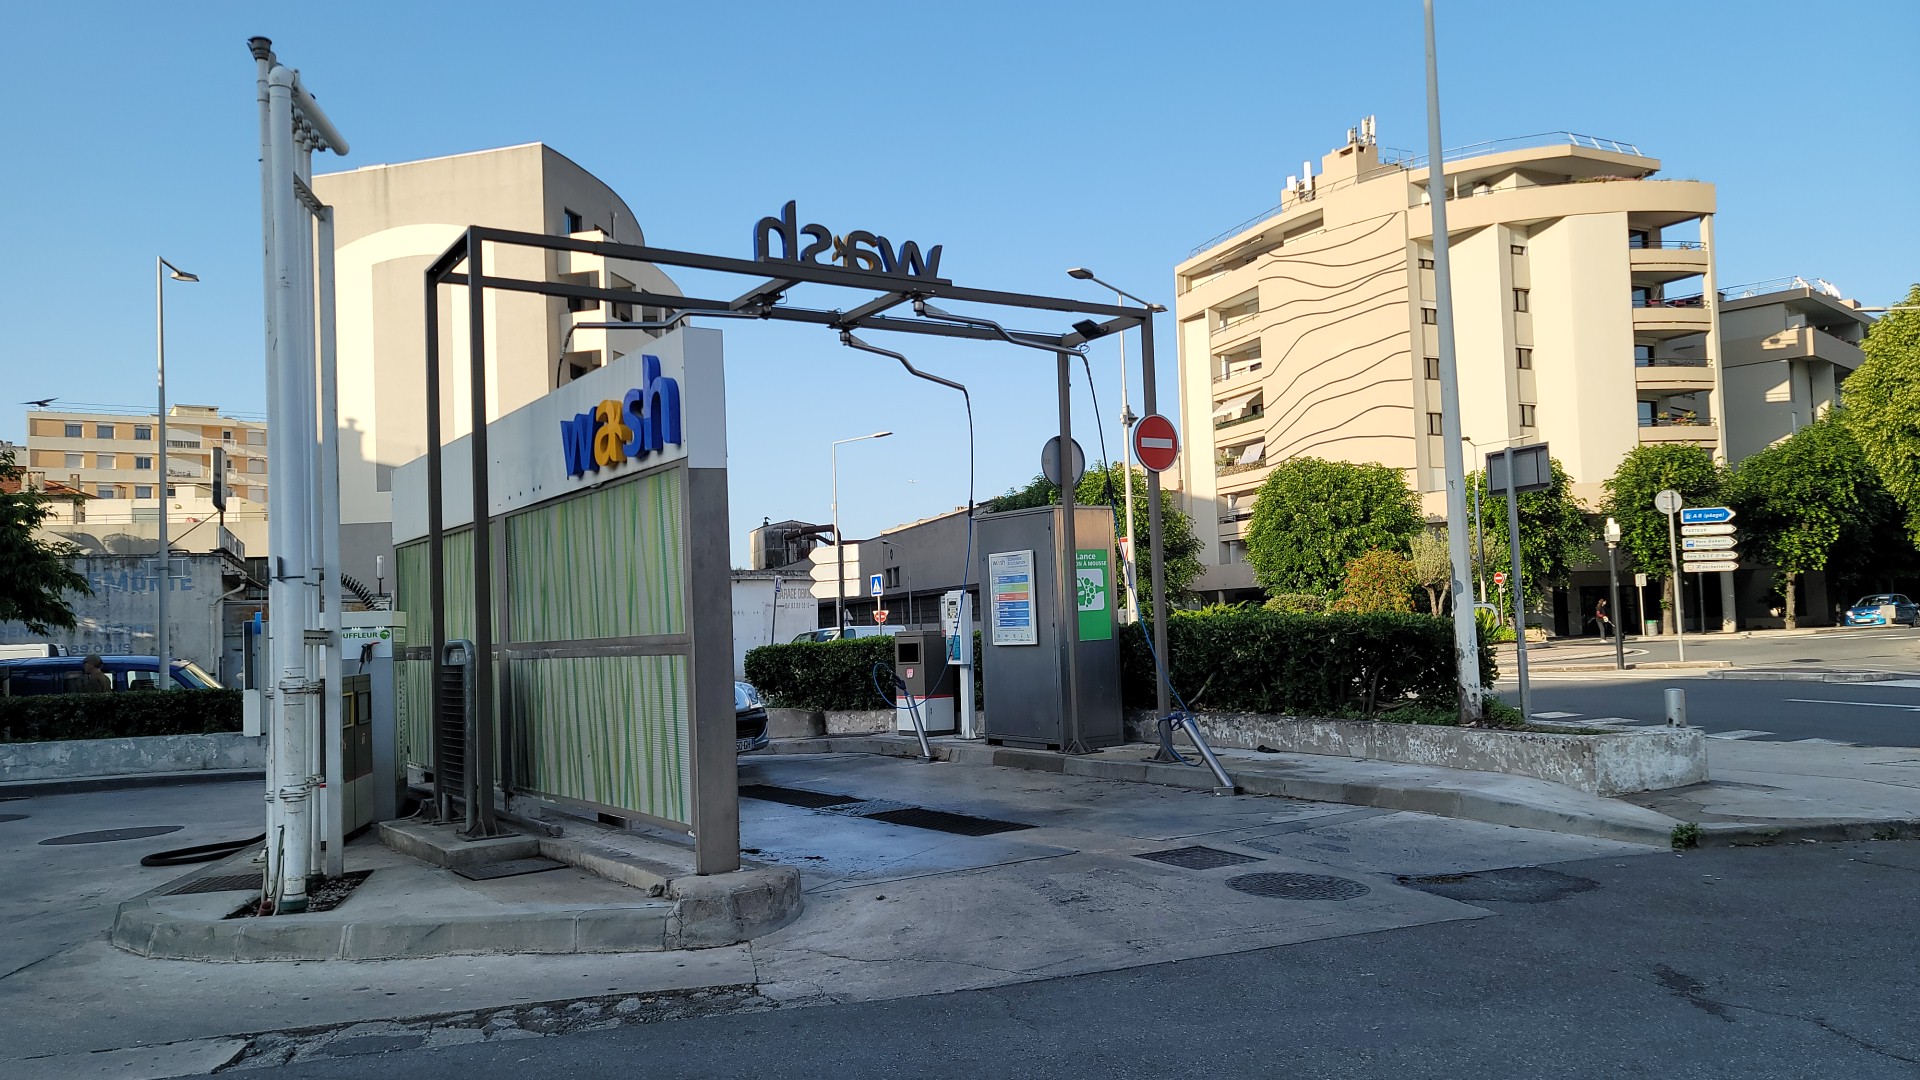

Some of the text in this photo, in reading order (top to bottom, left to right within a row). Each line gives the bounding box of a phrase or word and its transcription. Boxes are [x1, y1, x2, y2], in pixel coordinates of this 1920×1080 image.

[560, 354, 681, 480] wash
[1703, 511, 1725, 519] (péage)
[1075, 552, 1097, 560] Lance
[1083, 559, 1088, 567] À
